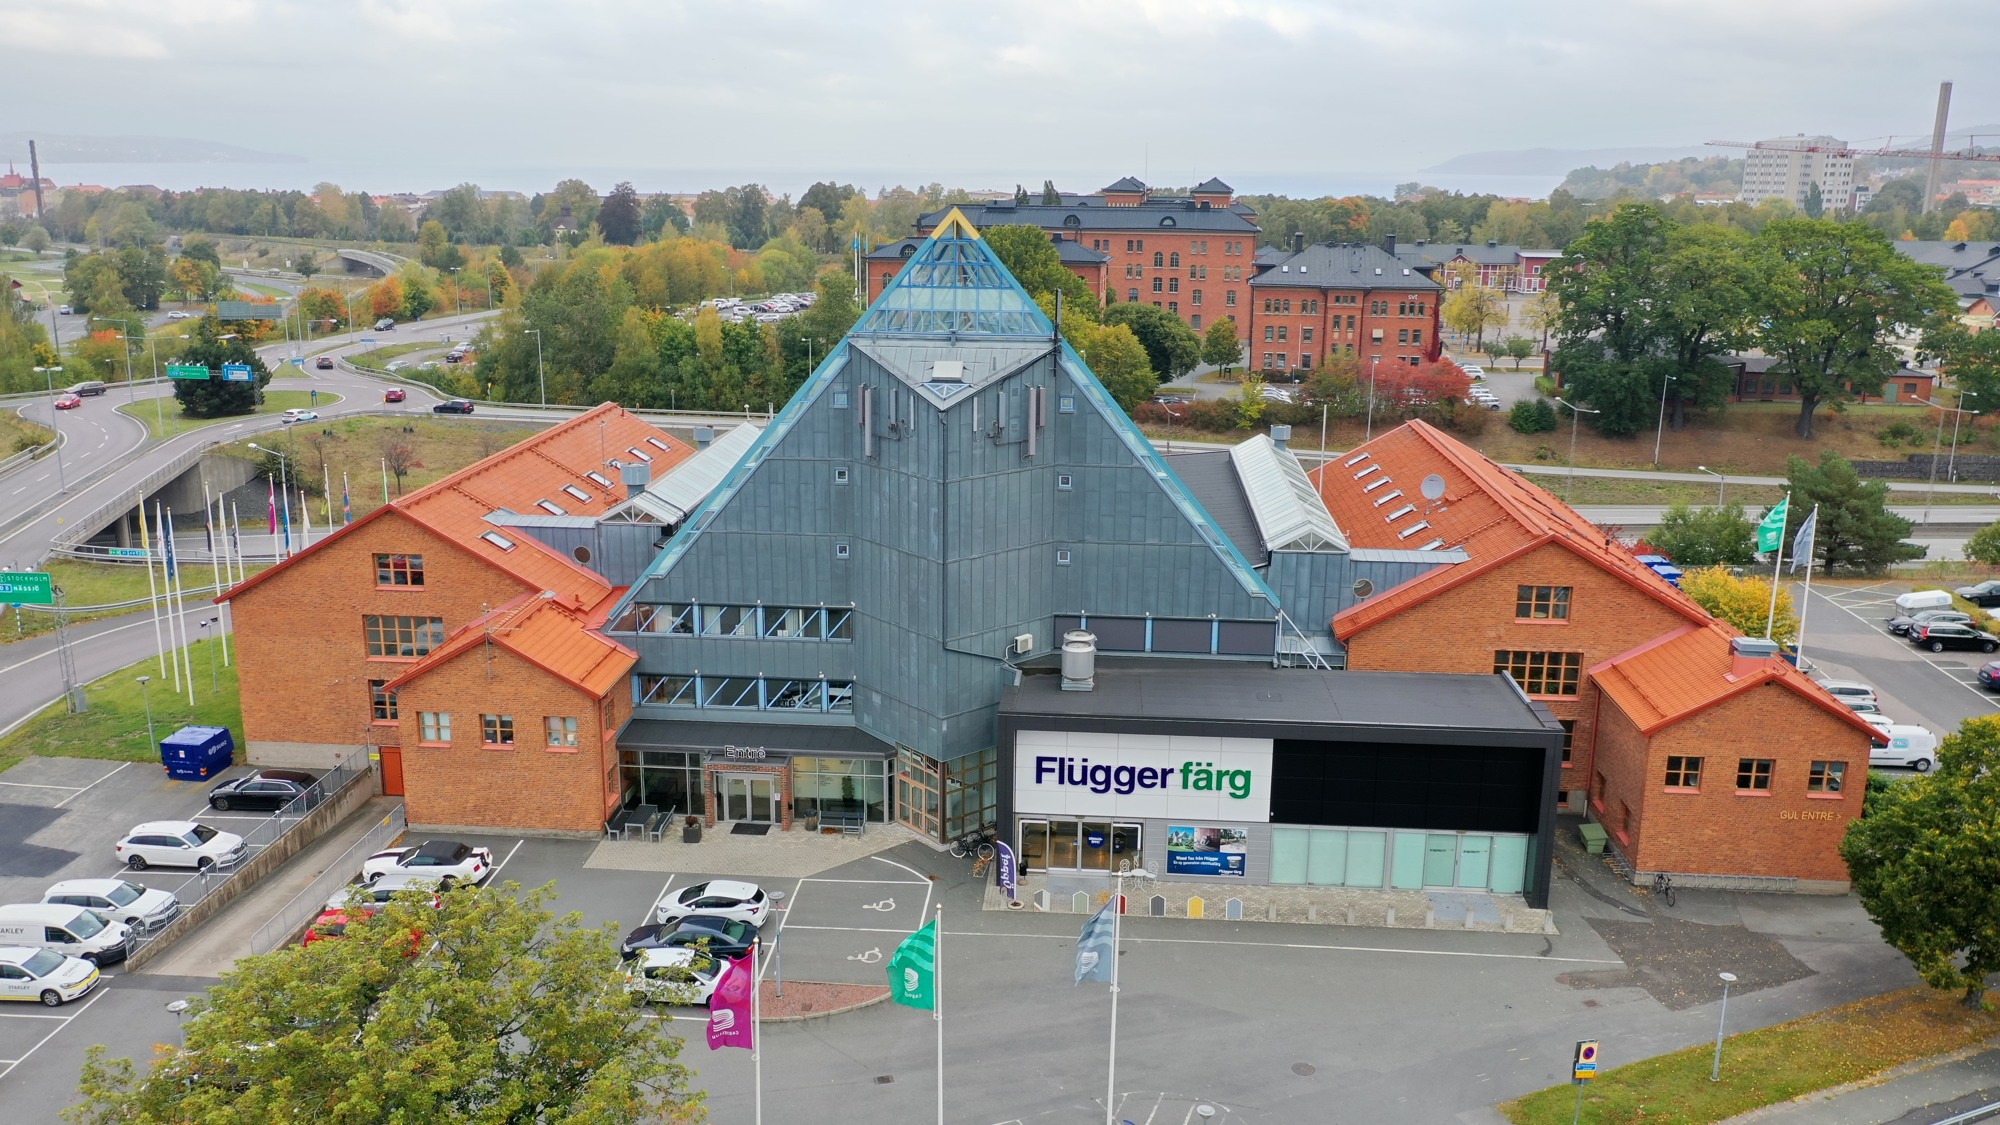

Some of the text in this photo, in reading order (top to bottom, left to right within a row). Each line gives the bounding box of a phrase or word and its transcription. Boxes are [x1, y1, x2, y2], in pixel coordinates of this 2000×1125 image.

[724, 744, 767, 760] Entré
[1035, 755, 1252, 799] Flügger färg
[1780, 810, 1834, 821] GUL ENTRE
